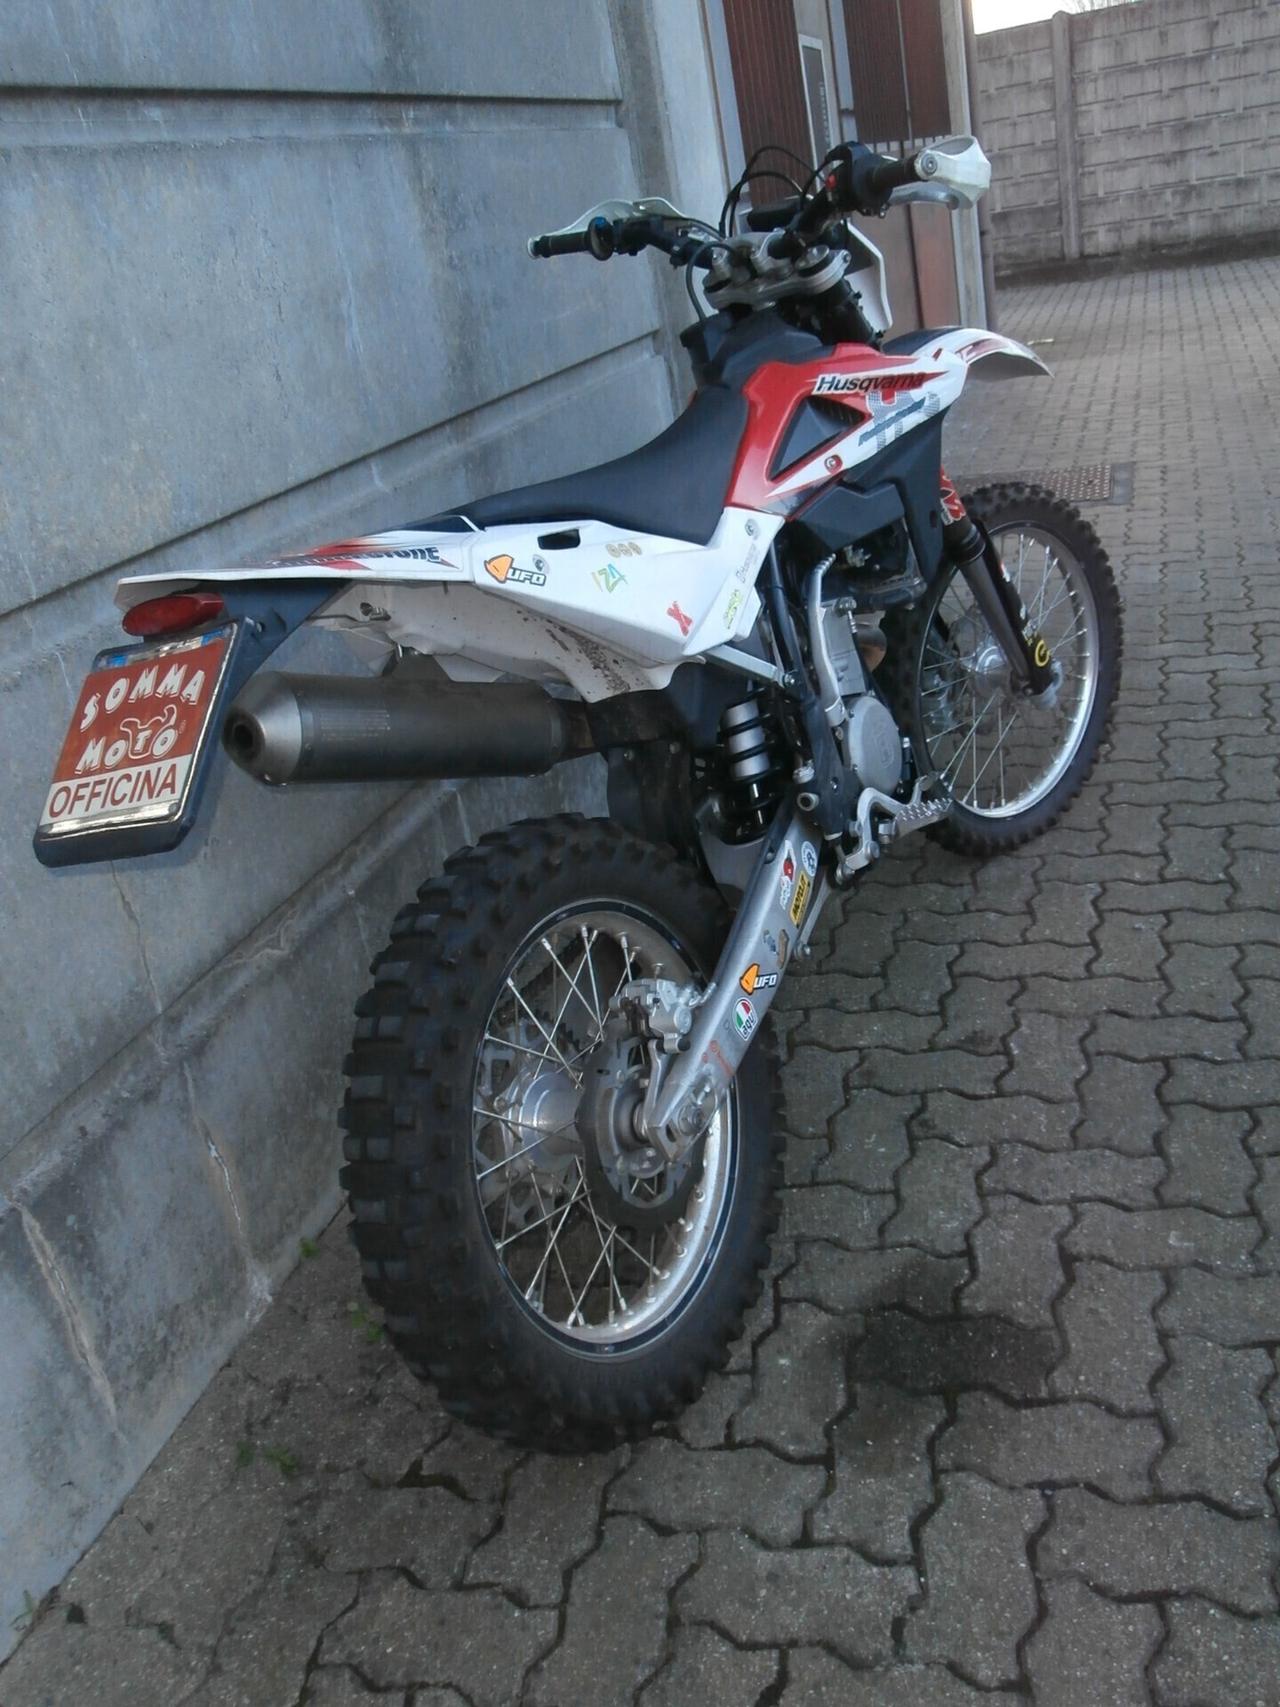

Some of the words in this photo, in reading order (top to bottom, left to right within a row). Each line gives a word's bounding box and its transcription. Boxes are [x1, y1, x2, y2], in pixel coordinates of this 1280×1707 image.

[816, 372, 924, 393] Husqvarna
[507, 566, 547, 586] UFO
[80, 664, 205, 732] SOMMA
[49, 763, 177, 818] OFFICINA
[754, 973, 777, 989] UFO
